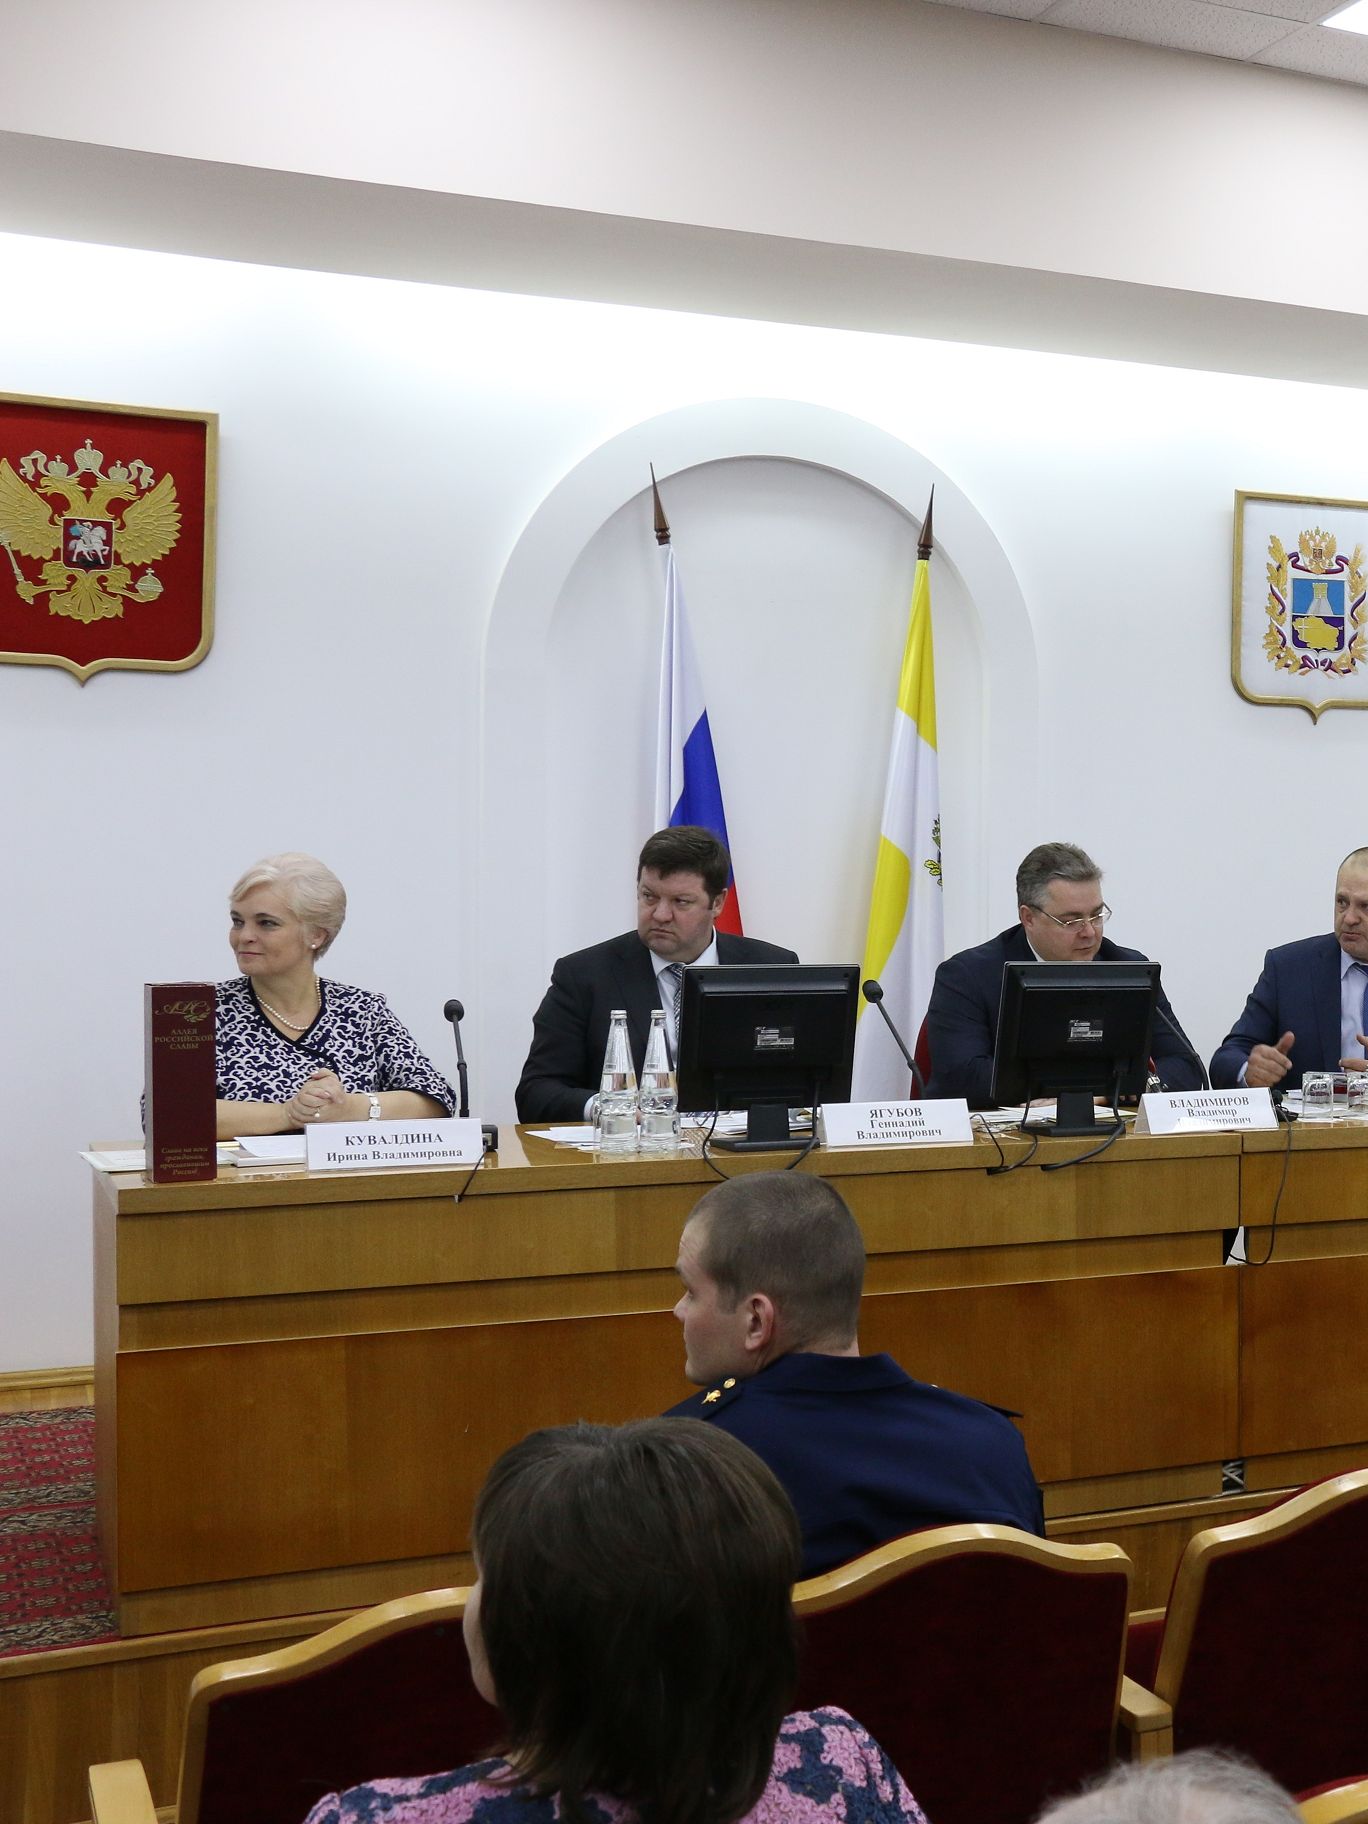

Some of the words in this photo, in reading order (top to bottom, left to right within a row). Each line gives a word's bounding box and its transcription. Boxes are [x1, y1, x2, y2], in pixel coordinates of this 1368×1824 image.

[1169, 1097, 1249, 1108] ВЛАДИМИРОВ
[870, 1107, 922, 1118] ЯГУБОВ
[1187, 1108, 1237, 1118] Владимир
[870, 1118, 925, 1128] Геннадий
[345, 1133, 443, 1146] КУВАЛДИНА
[856, 1128, 942, 1140] Владимирович
[327, 1152, 368, 1163] Ирина
[372, 1150, 463, 1162] Владимировна
